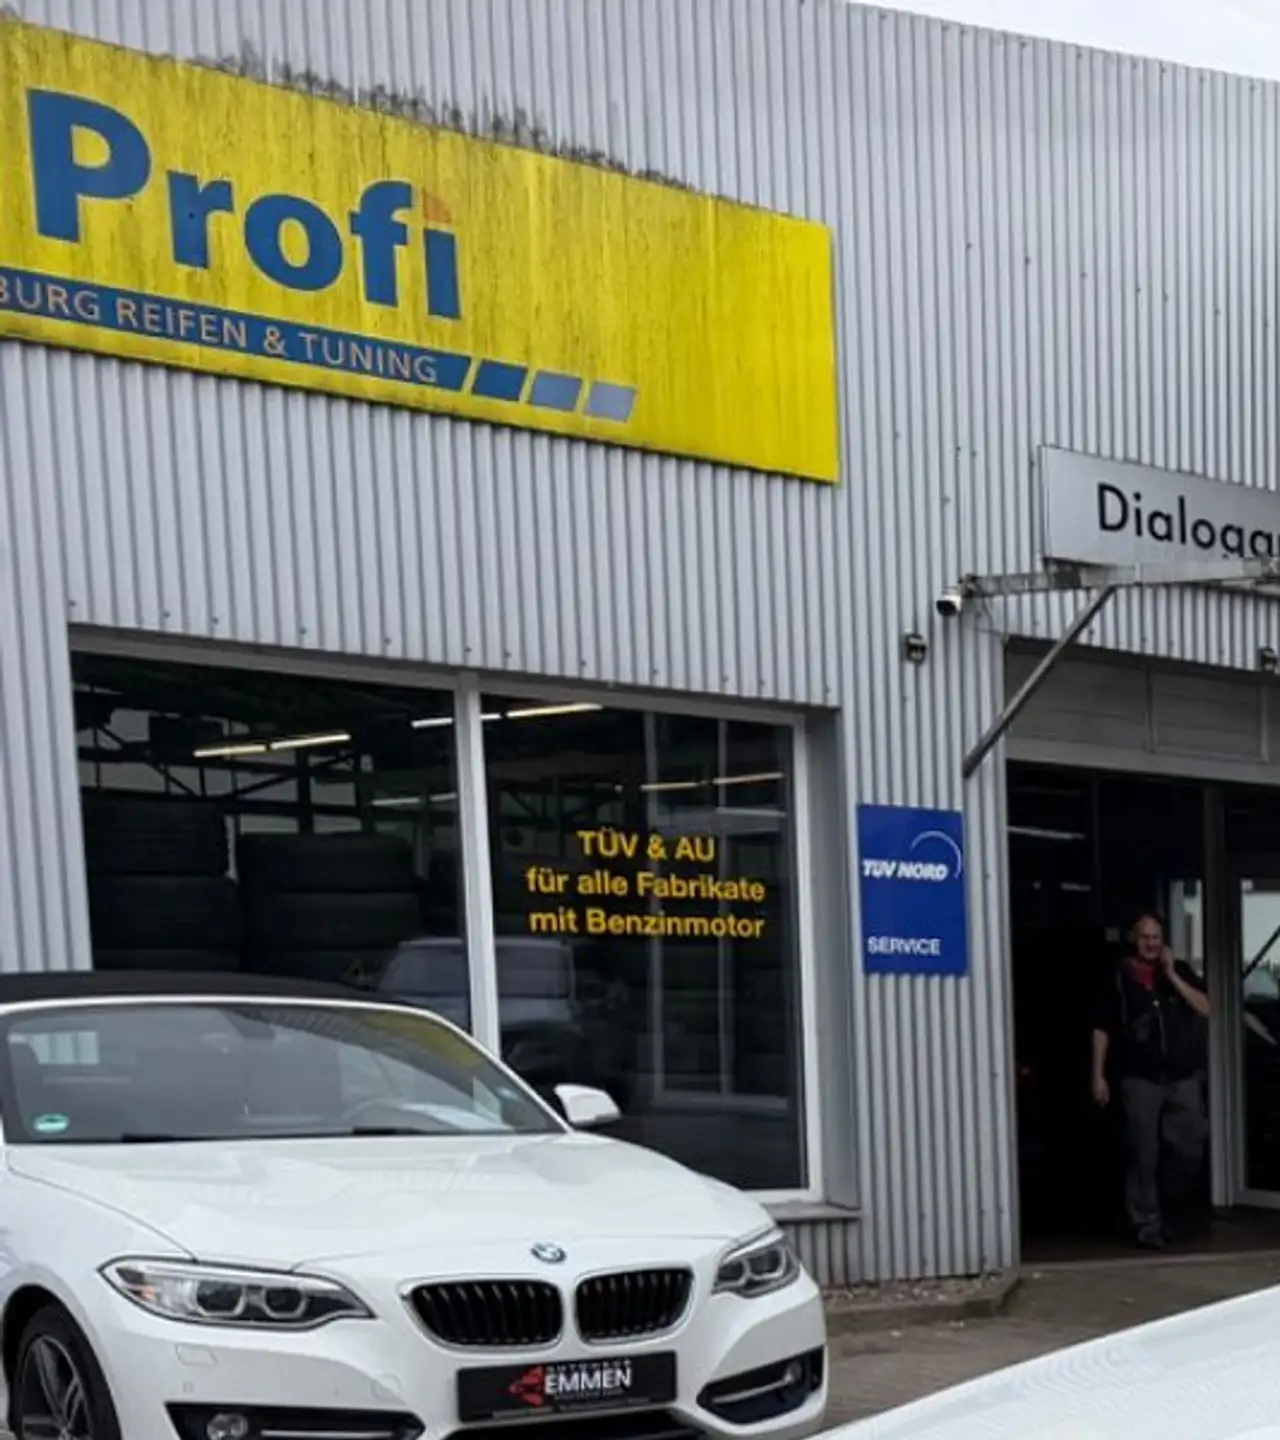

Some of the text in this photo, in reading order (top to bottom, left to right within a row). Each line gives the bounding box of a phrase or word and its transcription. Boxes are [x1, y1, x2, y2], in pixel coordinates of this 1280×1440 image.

[26, 87, 461, 320] Profi
[115, 297, 246, 348] REIFEN
[264, 325, 289, 357] &
[298, 332, 437, 383] TUNING
[577, 827, 715, 861] TÜV & AU
[526, 866, 766, 900] für alle Fabrikate
[897, 862, 949, 881] NORD
[530, 907, 765, 937] mit Benzinmotor
[867, 936, 940, 956] SERVICE
[545, 1368, 632, 1393] EMMEN
